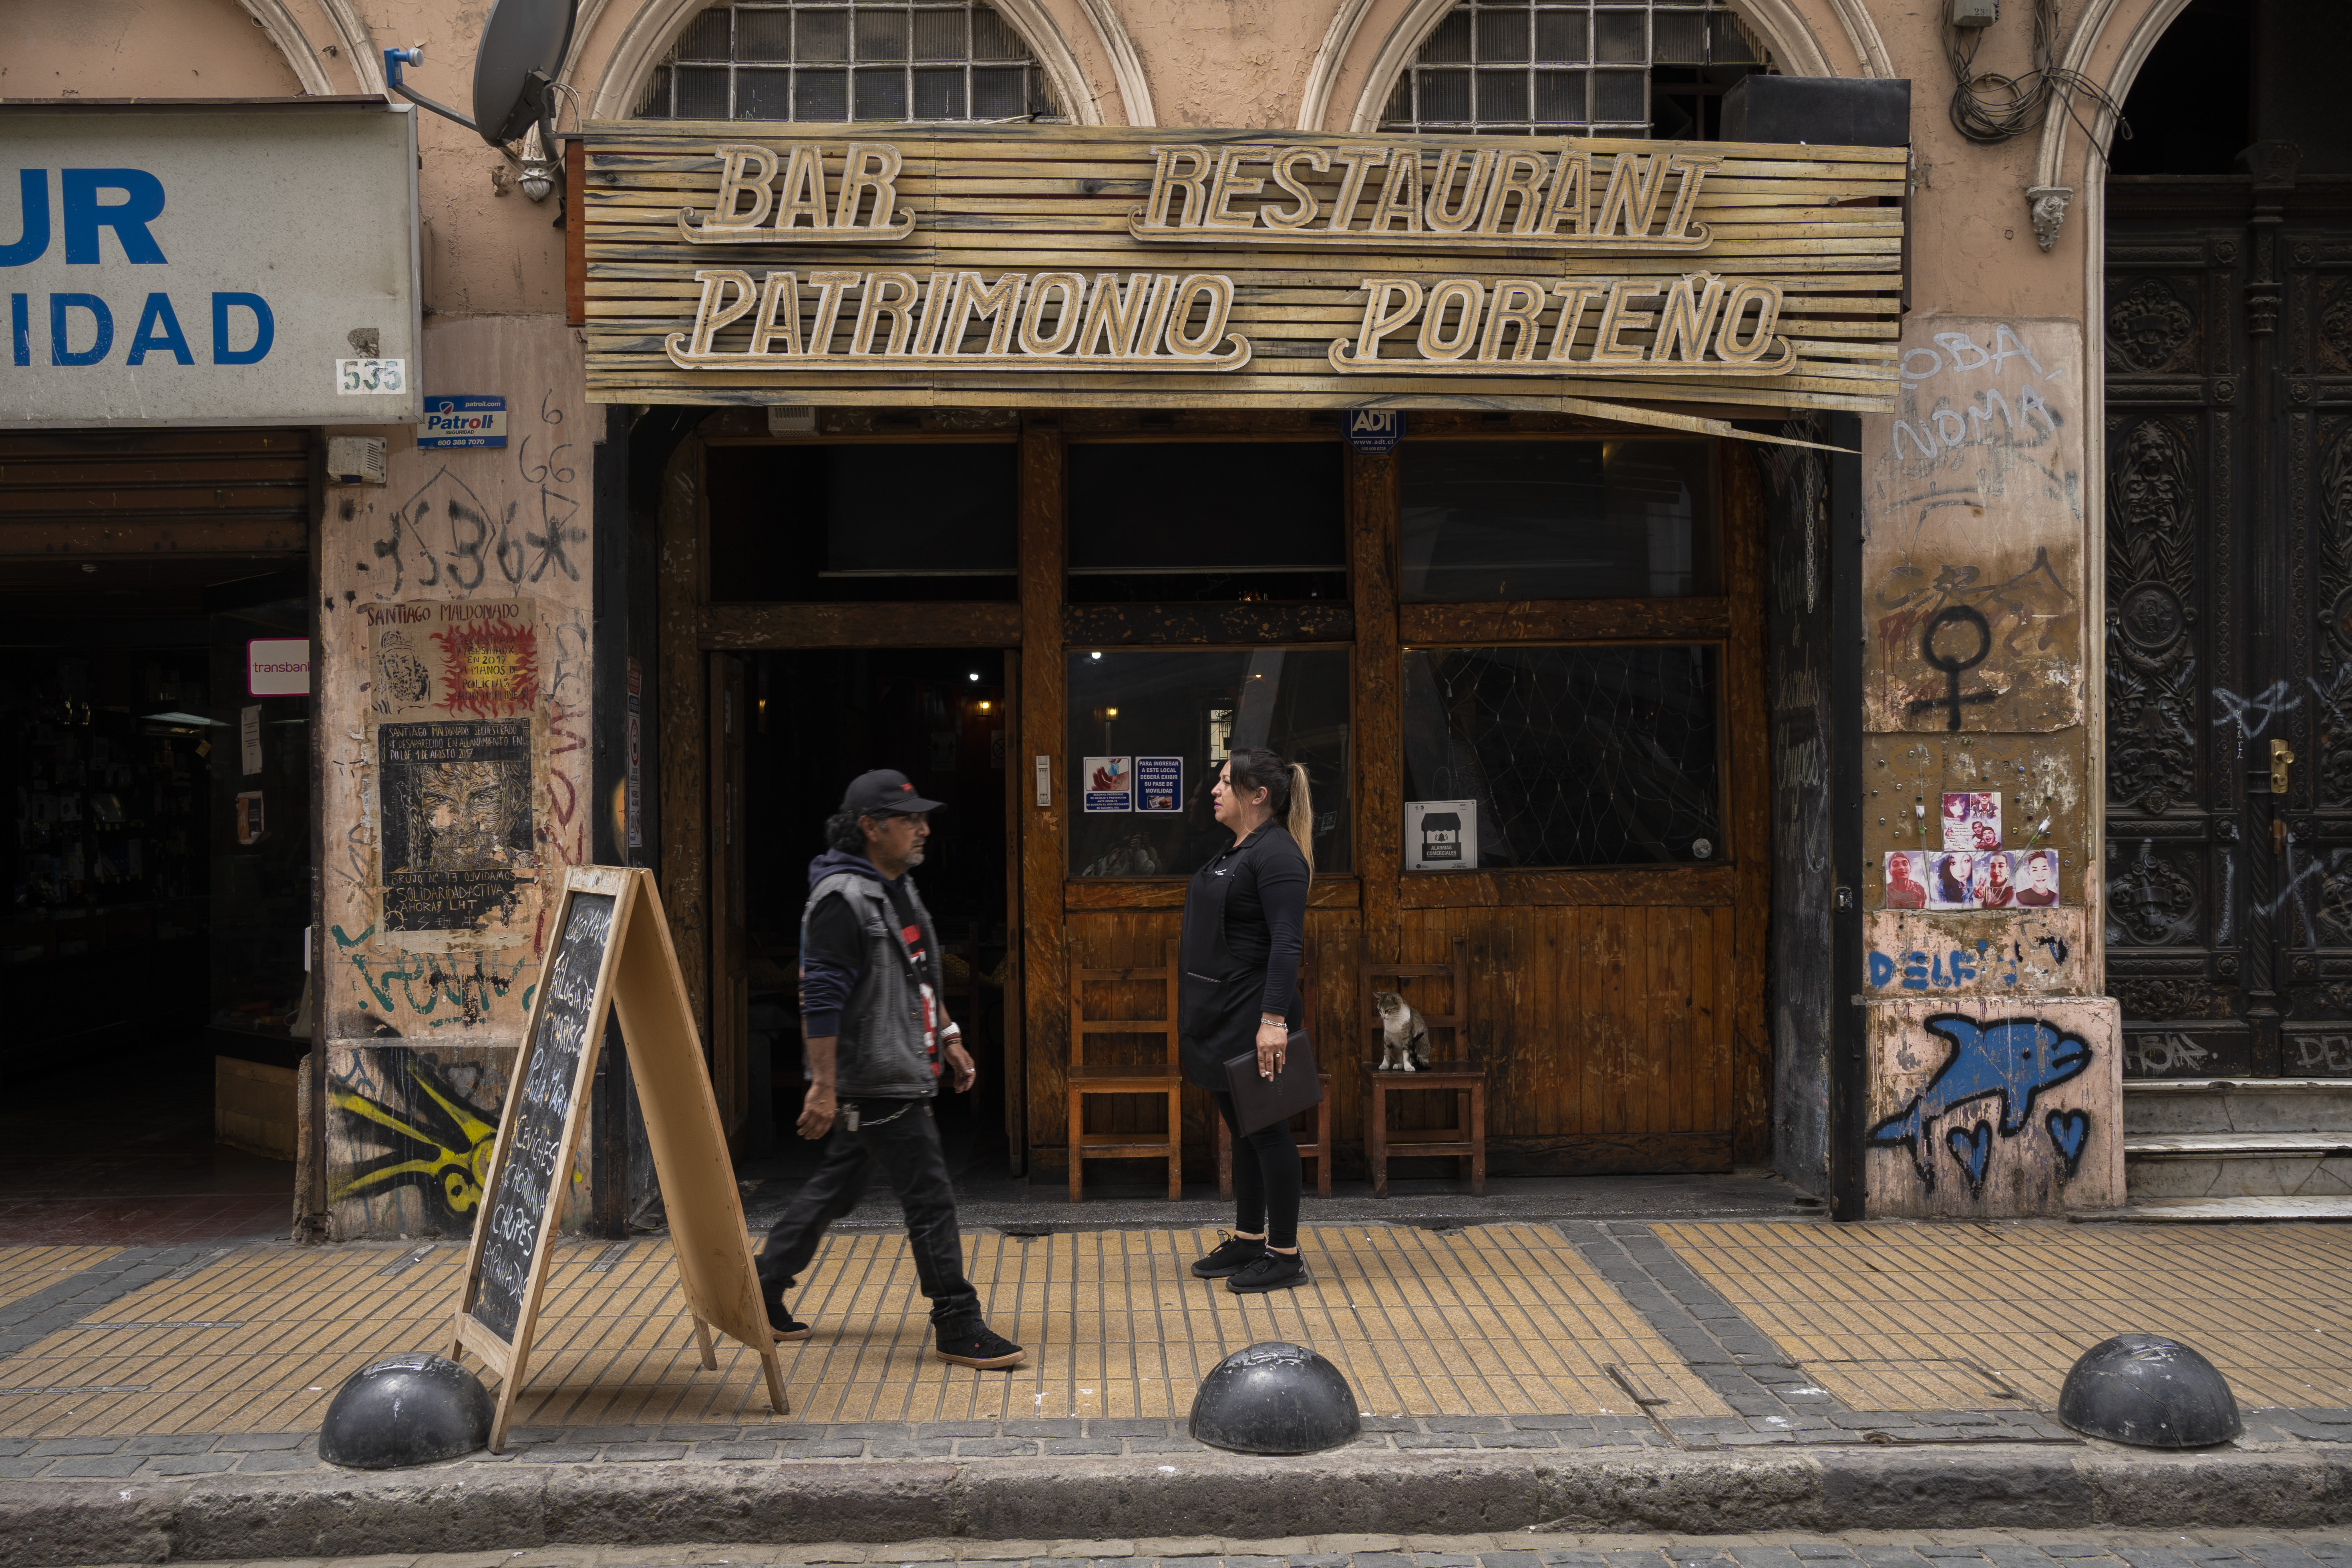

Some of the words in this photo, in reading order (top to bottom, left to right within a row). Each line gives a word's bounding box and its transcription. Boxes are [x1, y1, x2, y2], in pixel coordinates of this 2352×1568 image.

[701, 142, 904, 229] BAR
[1142, 143, 1724, 238] RESTAURANT
[689, 269, 1236, 356] PATRIMONIO
[1354, 270, 1785, 364] PORTEÑO
[11, 292, 275, 366] IDAD
[339, 360, 402, 391] 535
[428, 415, 493, 430] Patroll
[1352, 410, 1396, 431] ADT
[440, 604, 519, 622] MALDONADO
[459, 634, 516, 646] SECUESTRADX
[456, 647, 461, 656] Y
[464, 646, 514, 655] ASESINADX
[482, 656, 506, 664] 2017
[471, 665, 505, 675] MANOS
[389, 727, 427, 737] SANTIAGO
[432, 726, 469, 736] MALDONADO
[474, 725, 517, 735] SECUESTRADO
[390, 739, 396, 749] Y
[398, 738, 443, 749] DESAPARECIDO
[448, 738, 457, 747] EN
[459, 737, 508, 747] ALLANAMIENTO
[513, 735, 523, 746] EN
[415, 750, 420, 760] 1
[421, 750, 428, 759] DE
[430, 749, 455, 759] AGOSTO
